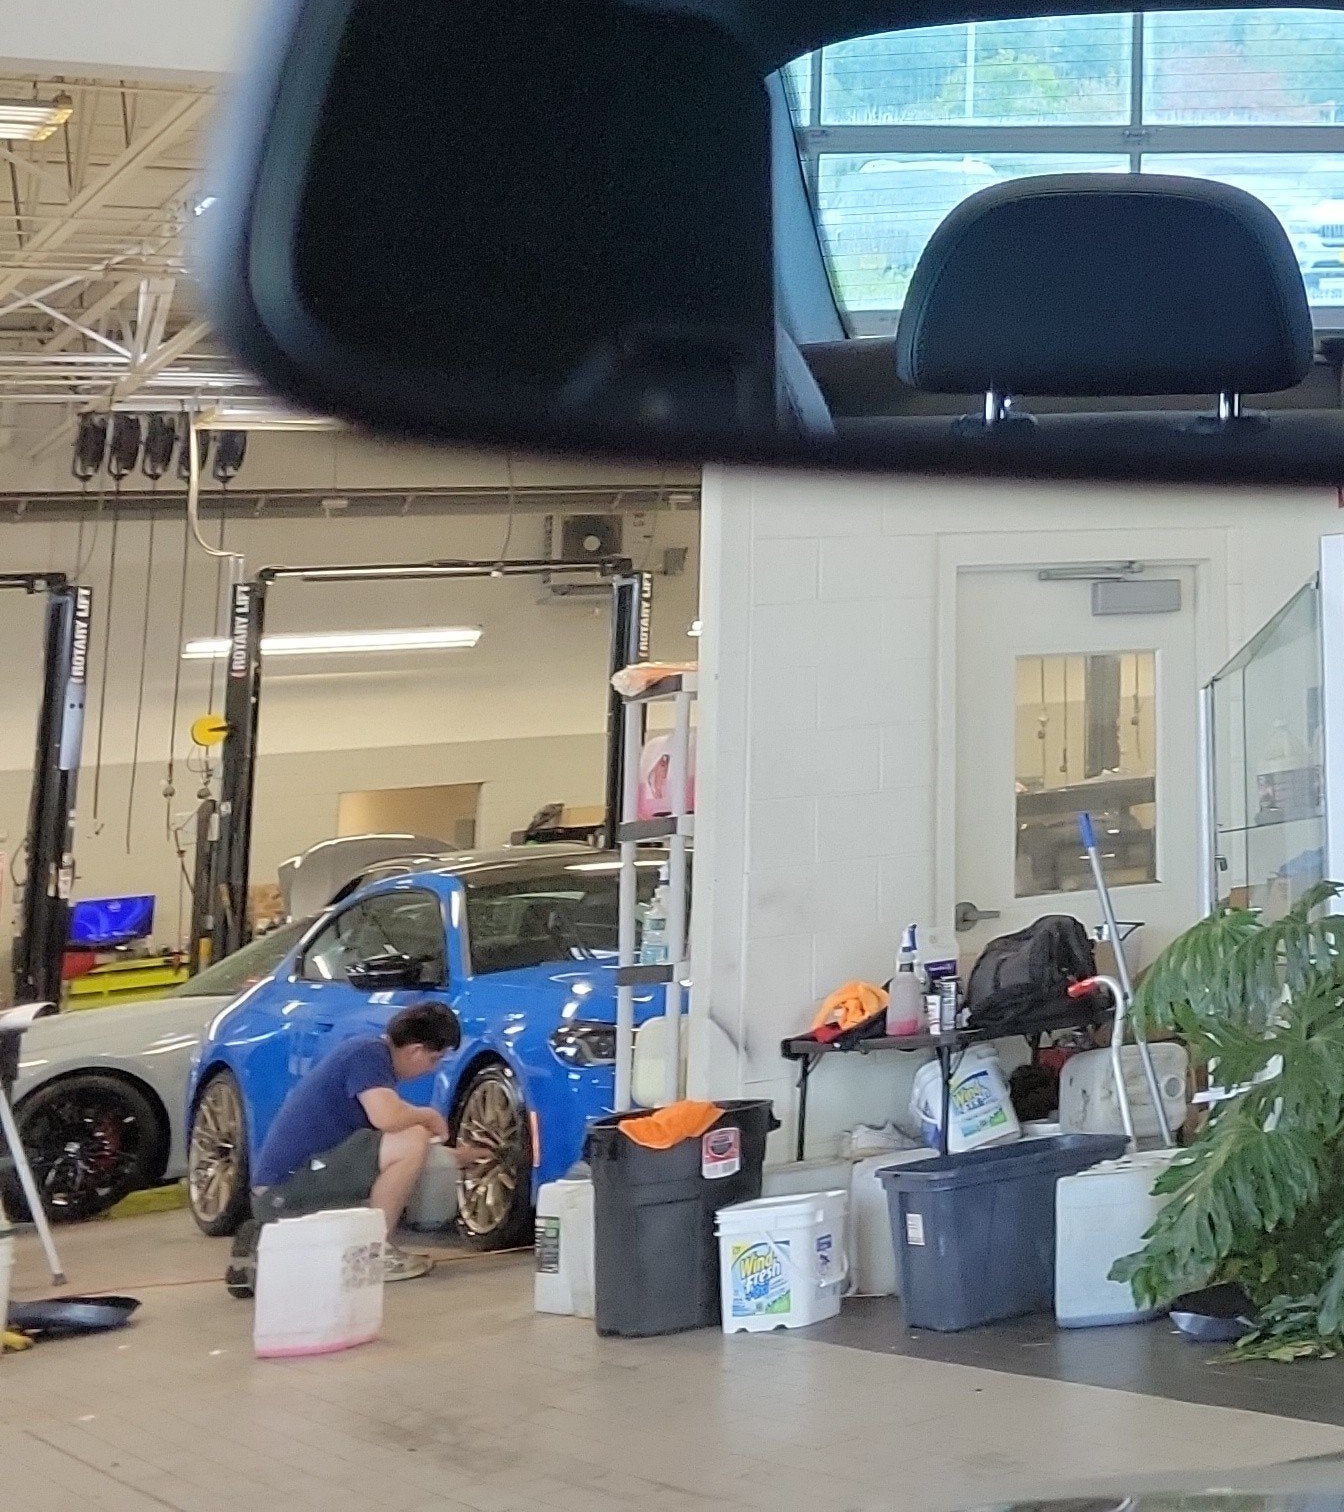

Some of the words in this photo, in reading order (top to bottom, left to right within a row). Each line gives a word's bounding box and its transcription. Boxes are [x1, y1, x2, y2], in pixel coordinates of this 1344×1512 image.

[75, 587, 91, 618] LIFT
[235, 585, 250, 614] LIFT
[71, 619, 88, 677] ROTARY
[232, 616, 250, 671] ROTARY
